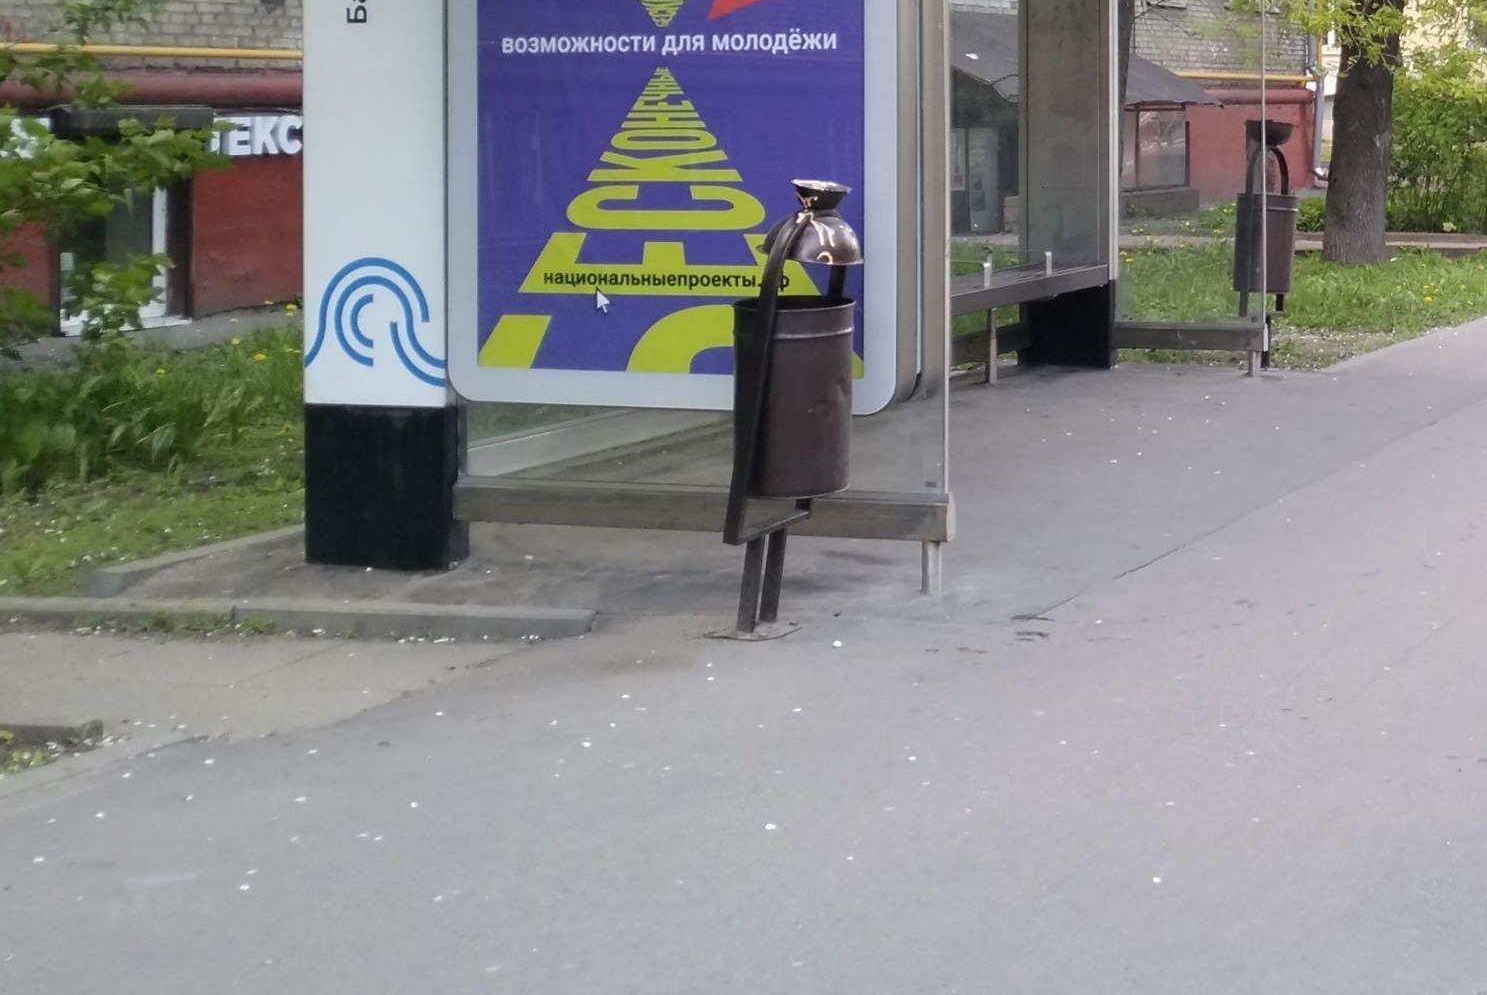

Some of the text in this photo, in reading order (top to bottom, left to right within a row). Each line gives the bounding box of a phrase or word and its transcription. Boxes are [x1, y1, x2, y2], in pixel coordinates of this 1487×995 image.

[502, 28, 837, 56] возможности для молодёжи
[543, 270, 790, 291] национальныепроекты.ф
